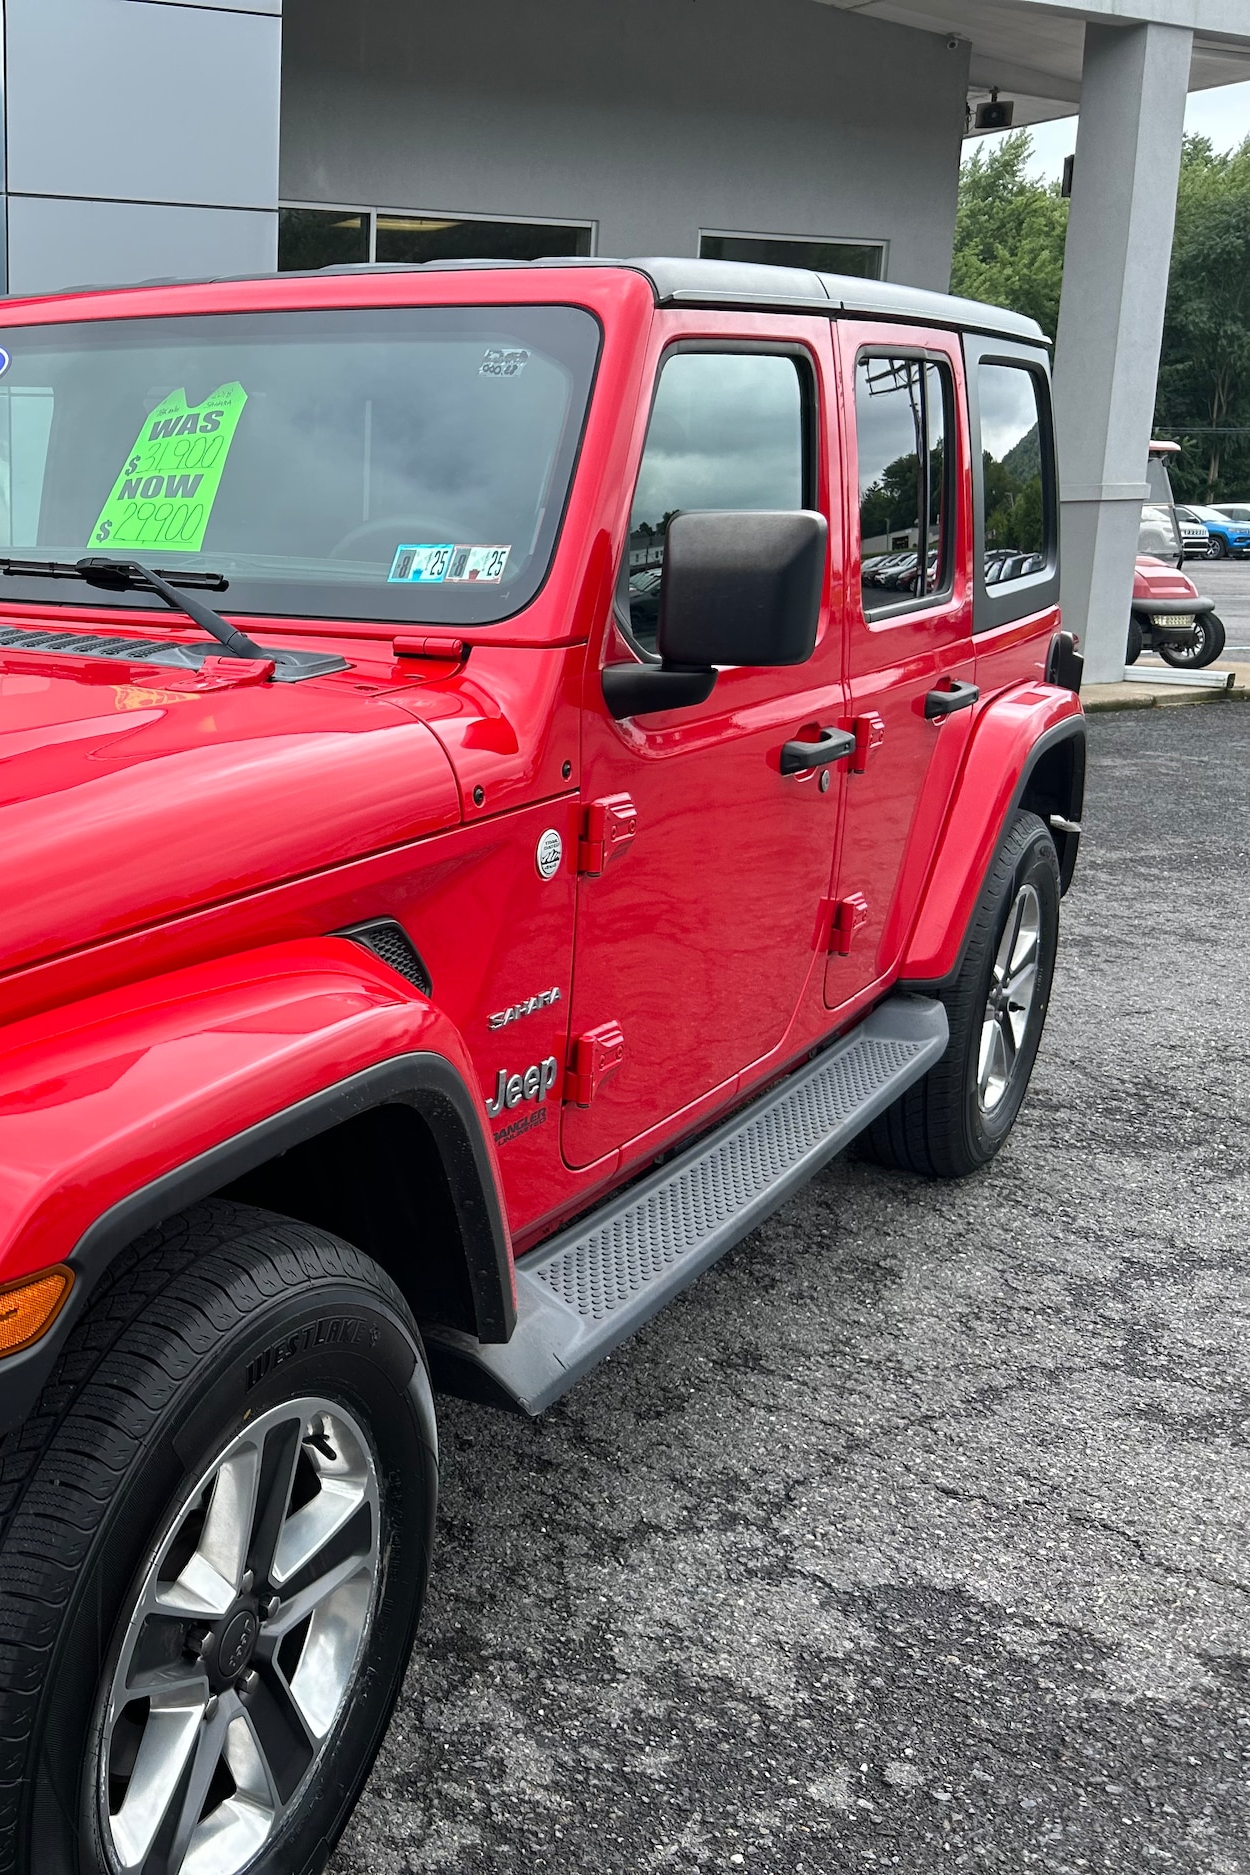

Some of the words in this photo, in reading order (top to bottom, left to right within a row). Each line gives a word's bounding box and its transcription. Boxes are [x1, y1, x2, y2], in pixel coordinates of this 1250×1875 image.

[148, 410, 225, 441] WAS
[116, 474, 205, 501] NOW
[487, 986, 562, 1031] SAHARA
[485, 1056, 558, 1119] Jeep
[246, 1316, 368, 1394] WESTLAKE
